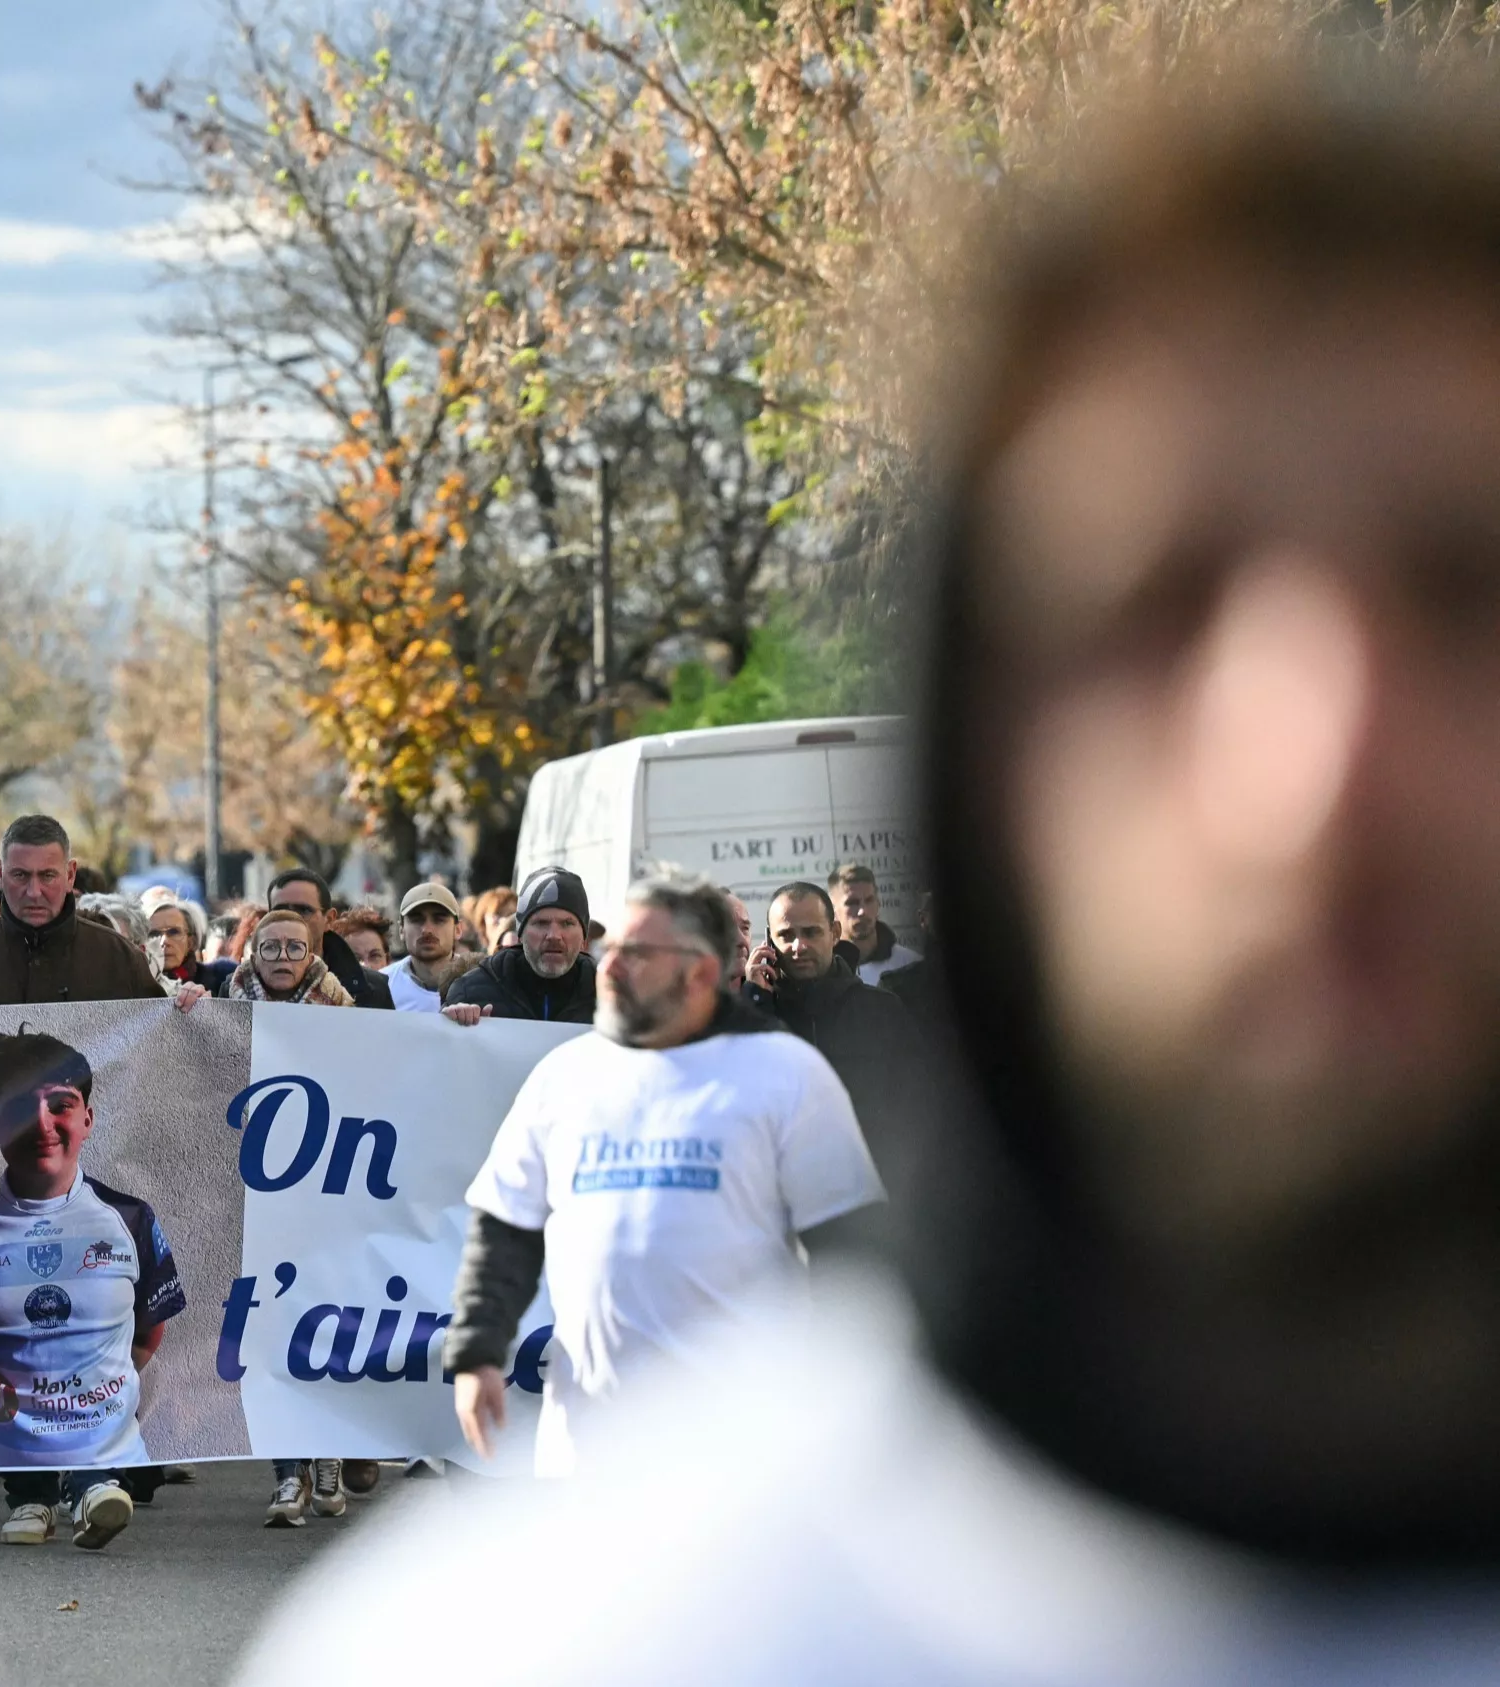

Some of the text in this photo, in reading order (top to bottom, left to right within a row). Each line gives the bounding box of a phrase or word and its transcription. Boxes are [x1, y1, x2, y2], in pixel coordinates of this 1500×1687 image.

[710, 830, 906, 862] L'ART DU TAPIS
[225, 1074, 398, 1201] On
[579, 1131, 723, 1163] Thomas
[31, 1424, 55, 1434] VENTE
[57, 1423, 66, 1431] ET
[67, 1418, 106, 1431] IMPRESS
